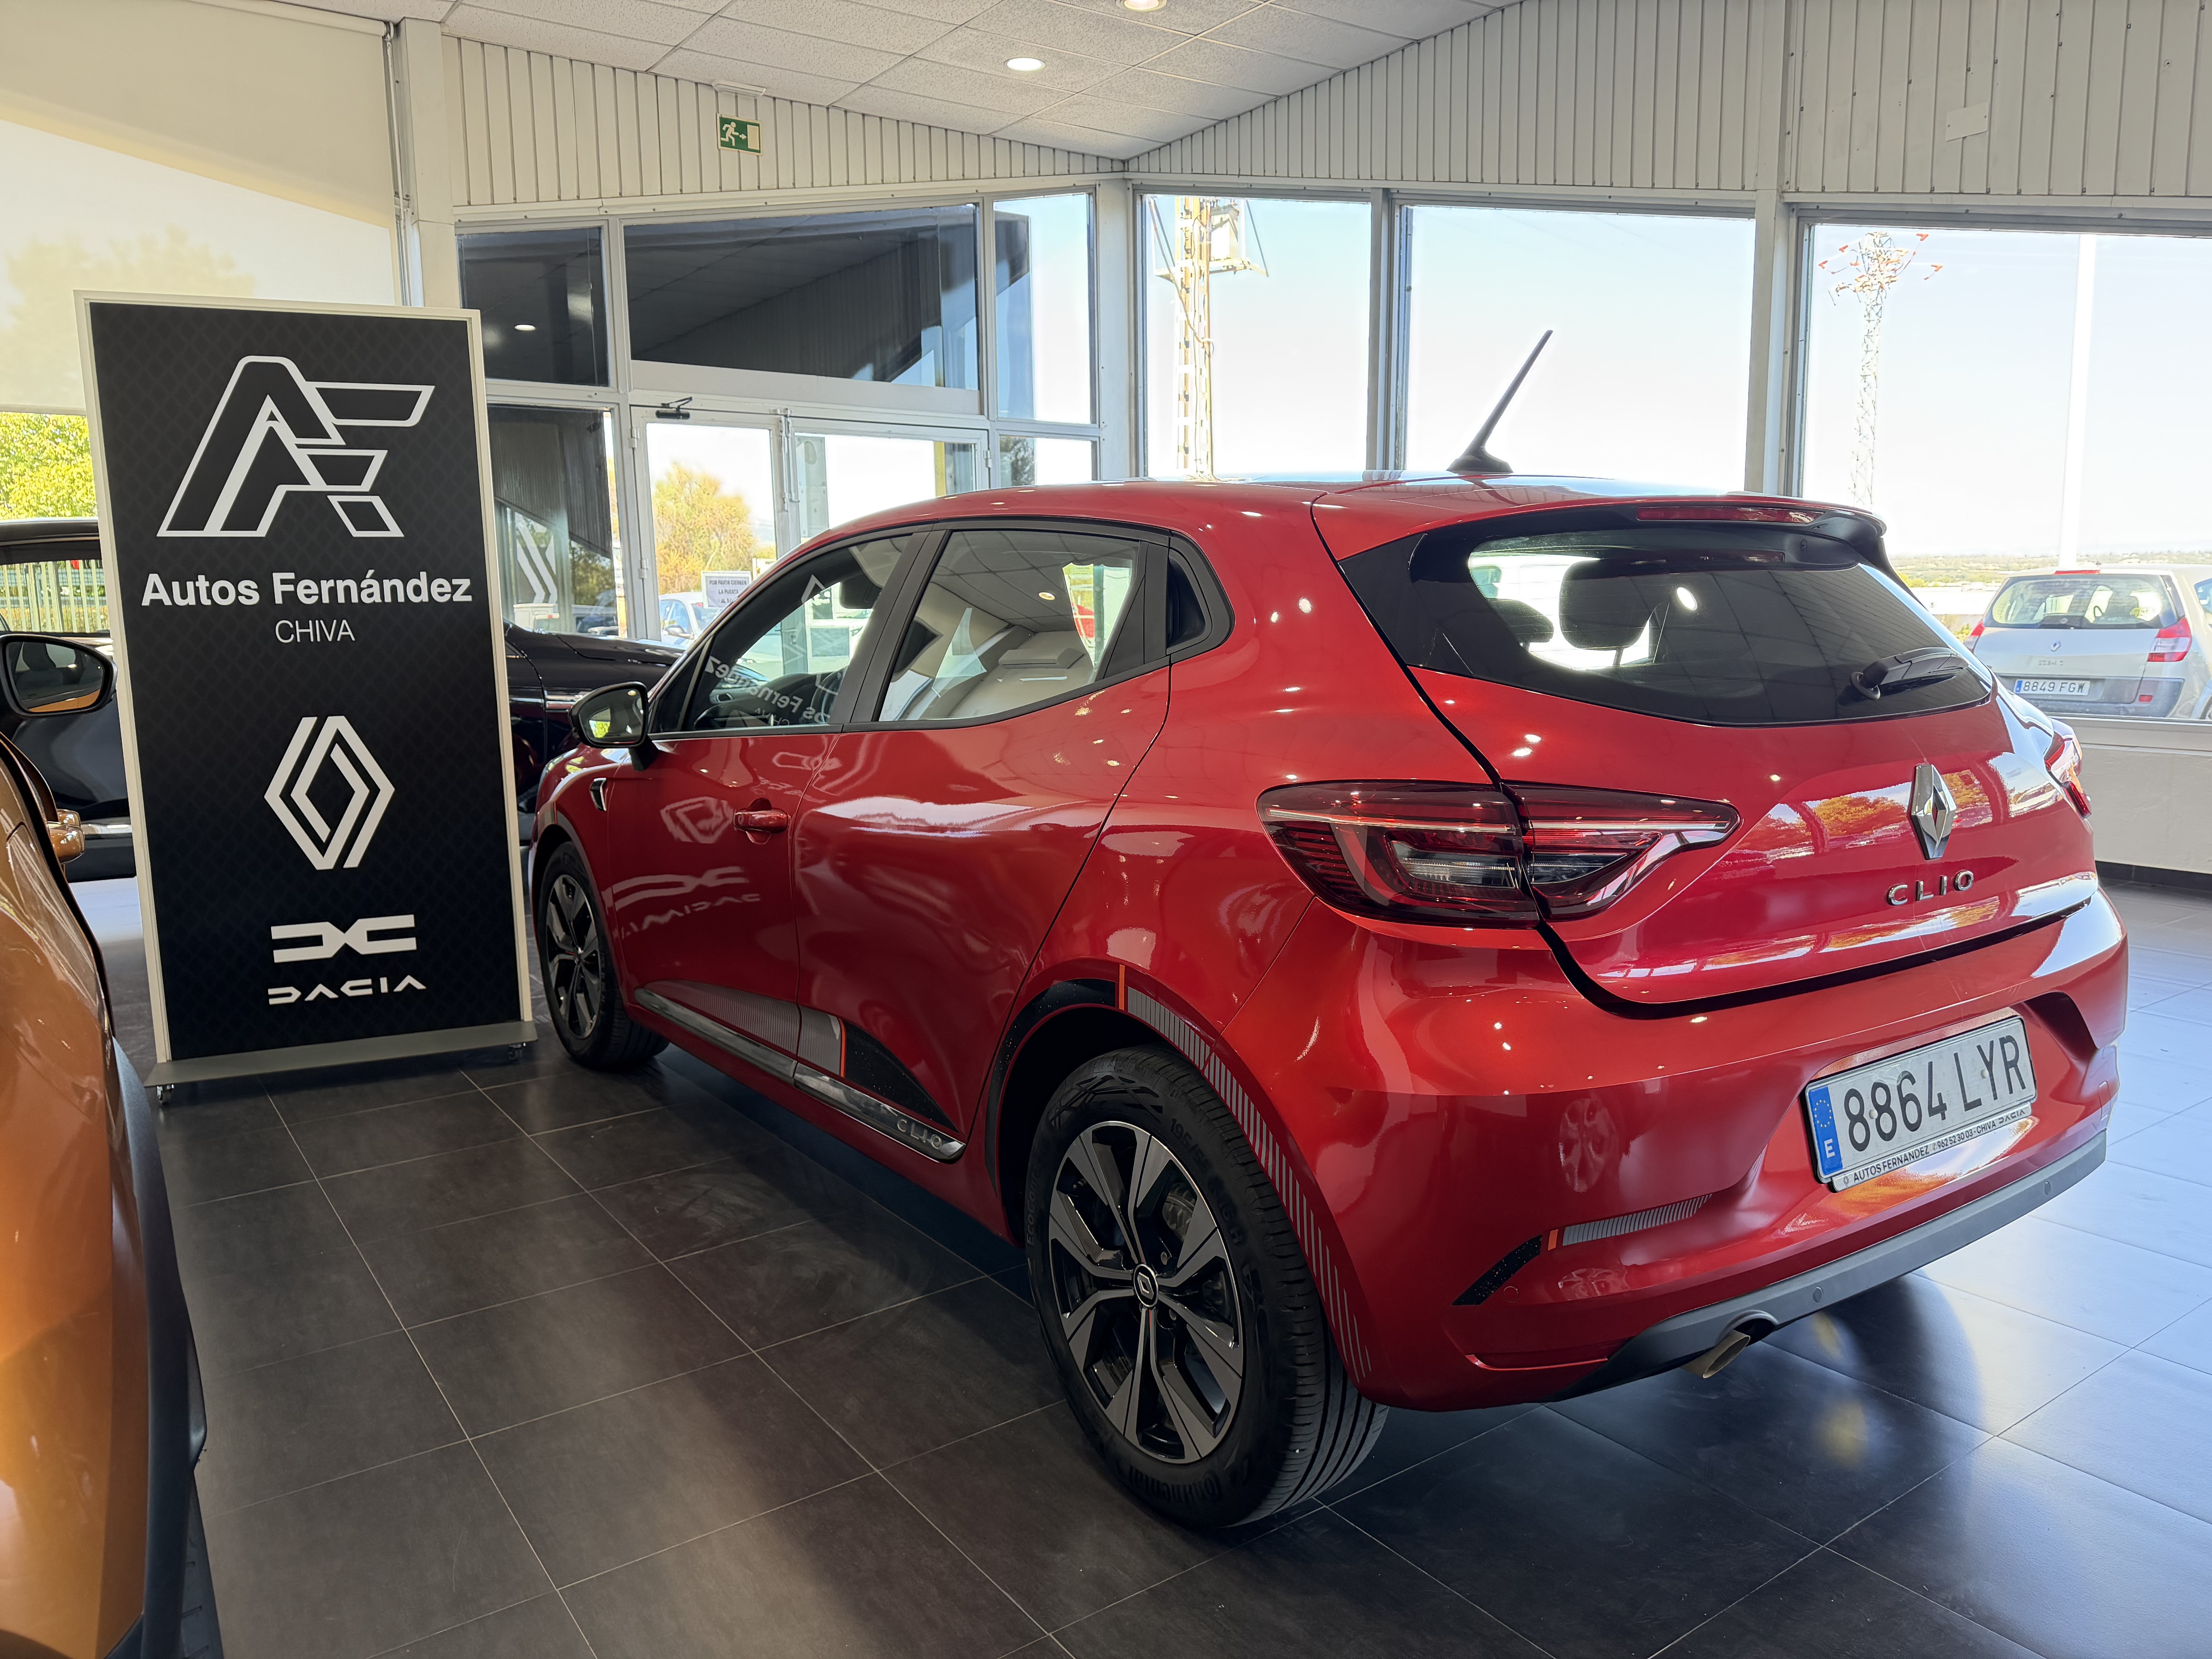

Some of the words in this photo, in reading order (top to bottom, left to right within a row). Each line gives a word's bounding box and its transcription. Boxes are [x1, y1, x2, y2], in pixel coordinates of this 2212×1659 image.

[141, 573, 259, 606] Autos
[273, 569, 472, 605] Fernández
[275, 620, 356, 643] CHIVA
[2023, 681, 2056, 692] 8849
[1886, 869, 1974, 906] CLIO
[268, 975, 426, 1005] DACIA
[1844, 1061, 1947, 1152] 8864
[1954, 1035, 2026, 1111] LYR
[896, 1119, 943, 1149] CLIO
[1824, 1139, 1835, 1159] E
[1853, 1164, 1882, 1183] AUTOS
[1882, 1145, 1930, 1171] FERNANDEZ
[1937, 1139, 1949, 1149] 962
[1976, 1120, 1997, 1134] CHIVA
[1998, 1109, 2025, 1124] DACIA
